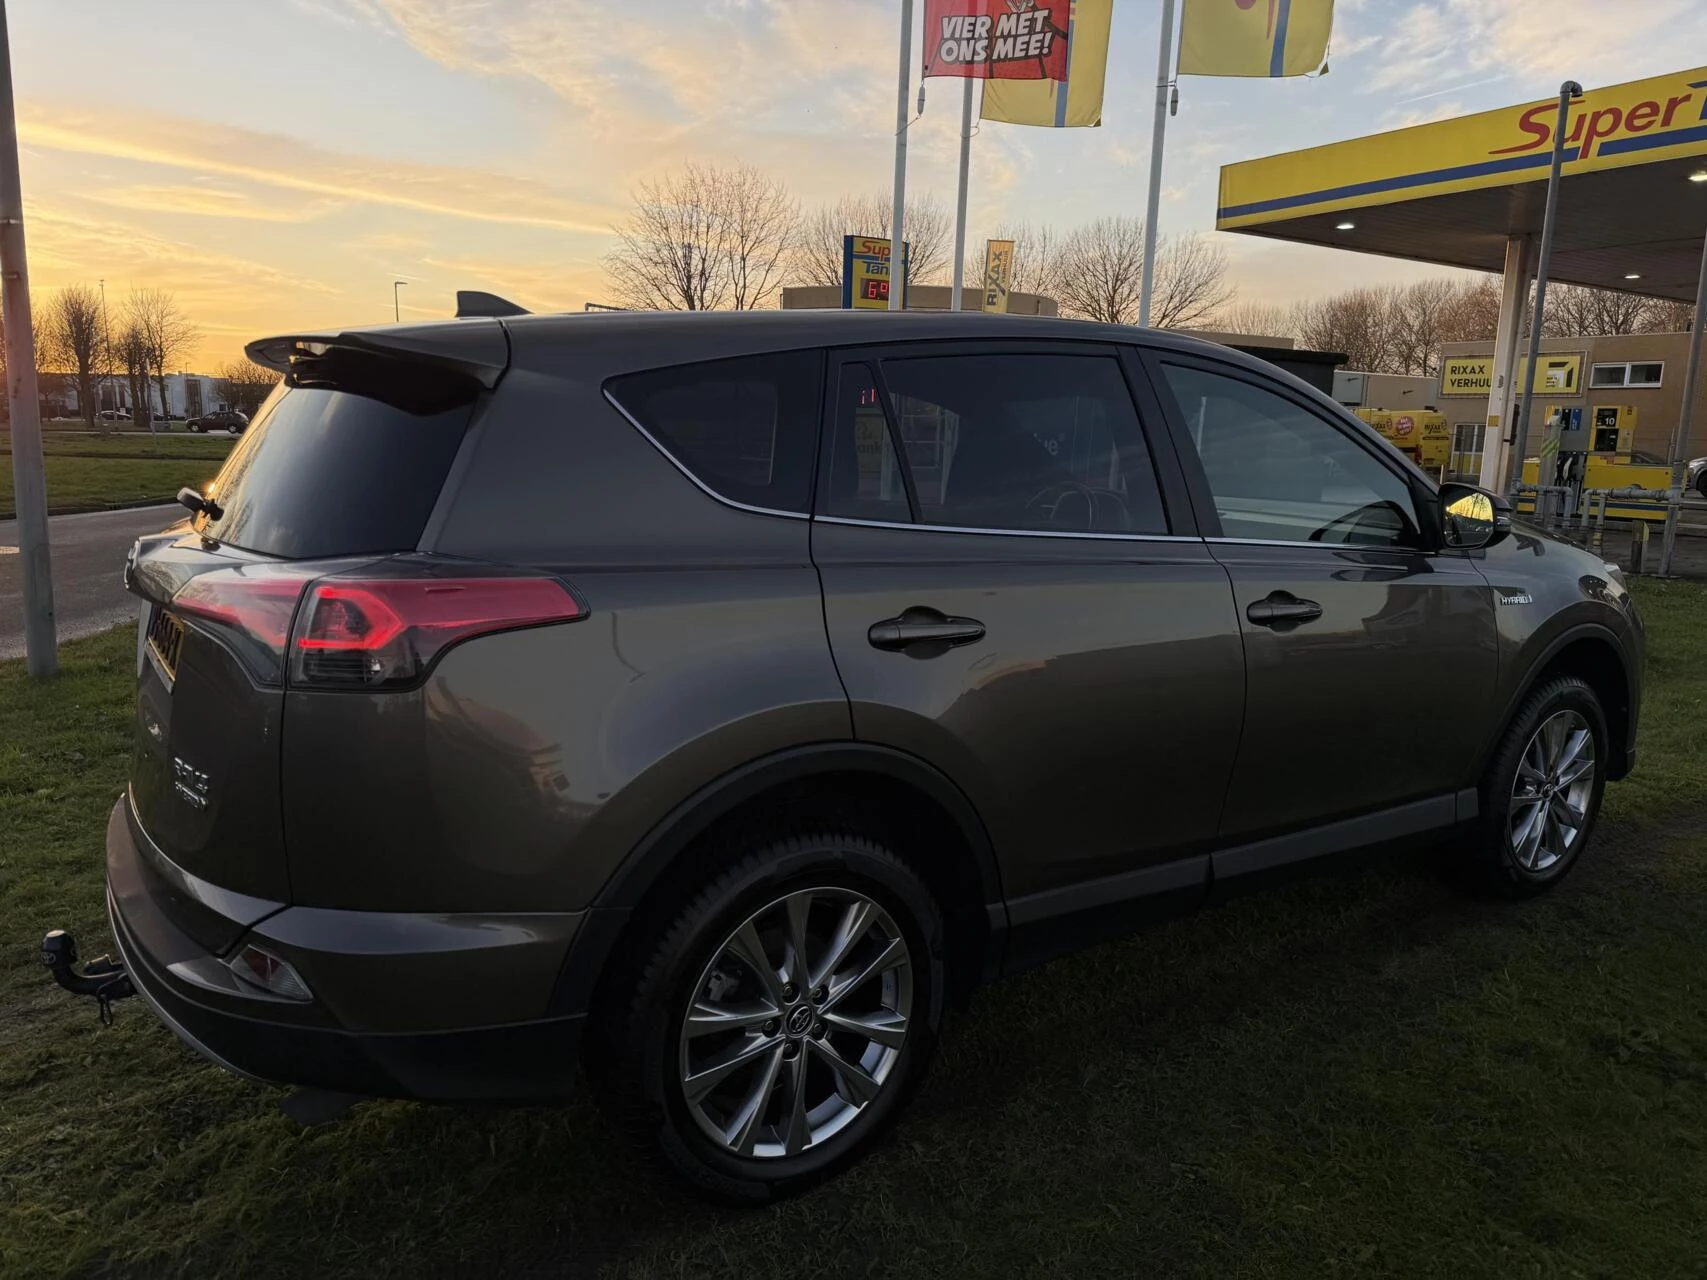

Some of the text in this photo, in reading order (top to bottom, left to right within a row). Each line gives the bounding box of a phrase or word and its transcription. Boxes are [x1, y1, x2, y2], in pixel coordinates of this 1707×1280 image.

[942, 9, 1050, 39] VIER MET
[940, 32, 1053, 62] ONS MEE!
[1488, 94, 1692, 160] Super
[855, 240, 890, 262] Sup
[862, 260, 890, 275] Tan
[1450, 365, 1485, 375] RIXAX
[1450, 377, 1493, 388] VERHUU
